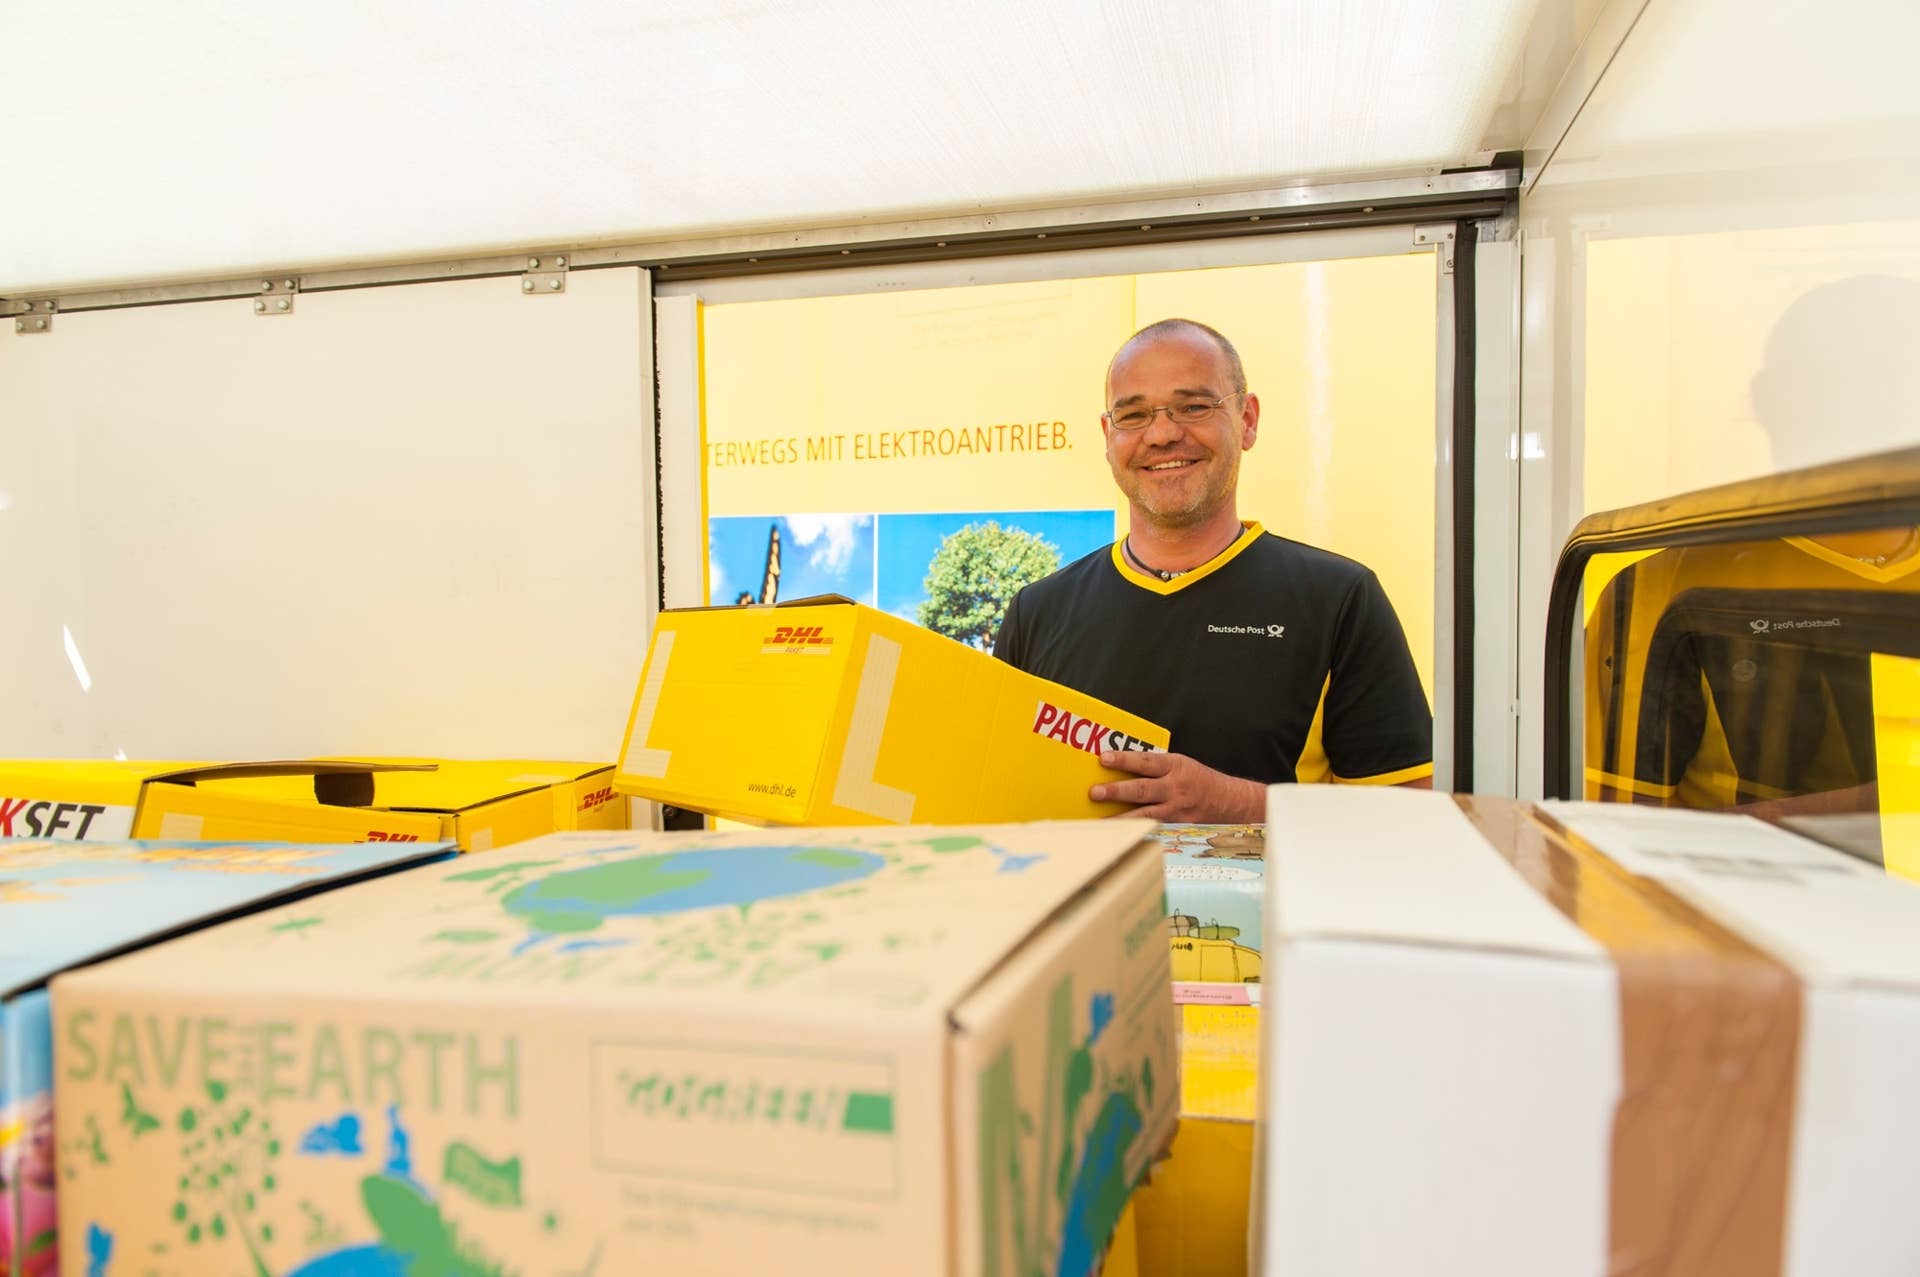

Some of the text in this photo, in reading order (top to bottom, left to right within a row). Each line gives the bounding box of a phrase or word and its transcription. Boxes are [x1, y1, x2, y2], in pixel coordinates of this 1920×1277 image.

[806, 434, 846, 462] MIT
[854, 421, 1073, 460] ELEKTROANTRIEB.
[772, 626, 824, 644] DHL
[1207, 624, 1265, 635] Deutsche Post
[583, 785, 612, 810] DHL
[65, 1008, 231, 1090] SAVE
[258, 1018, 521, 1118] EARTH
